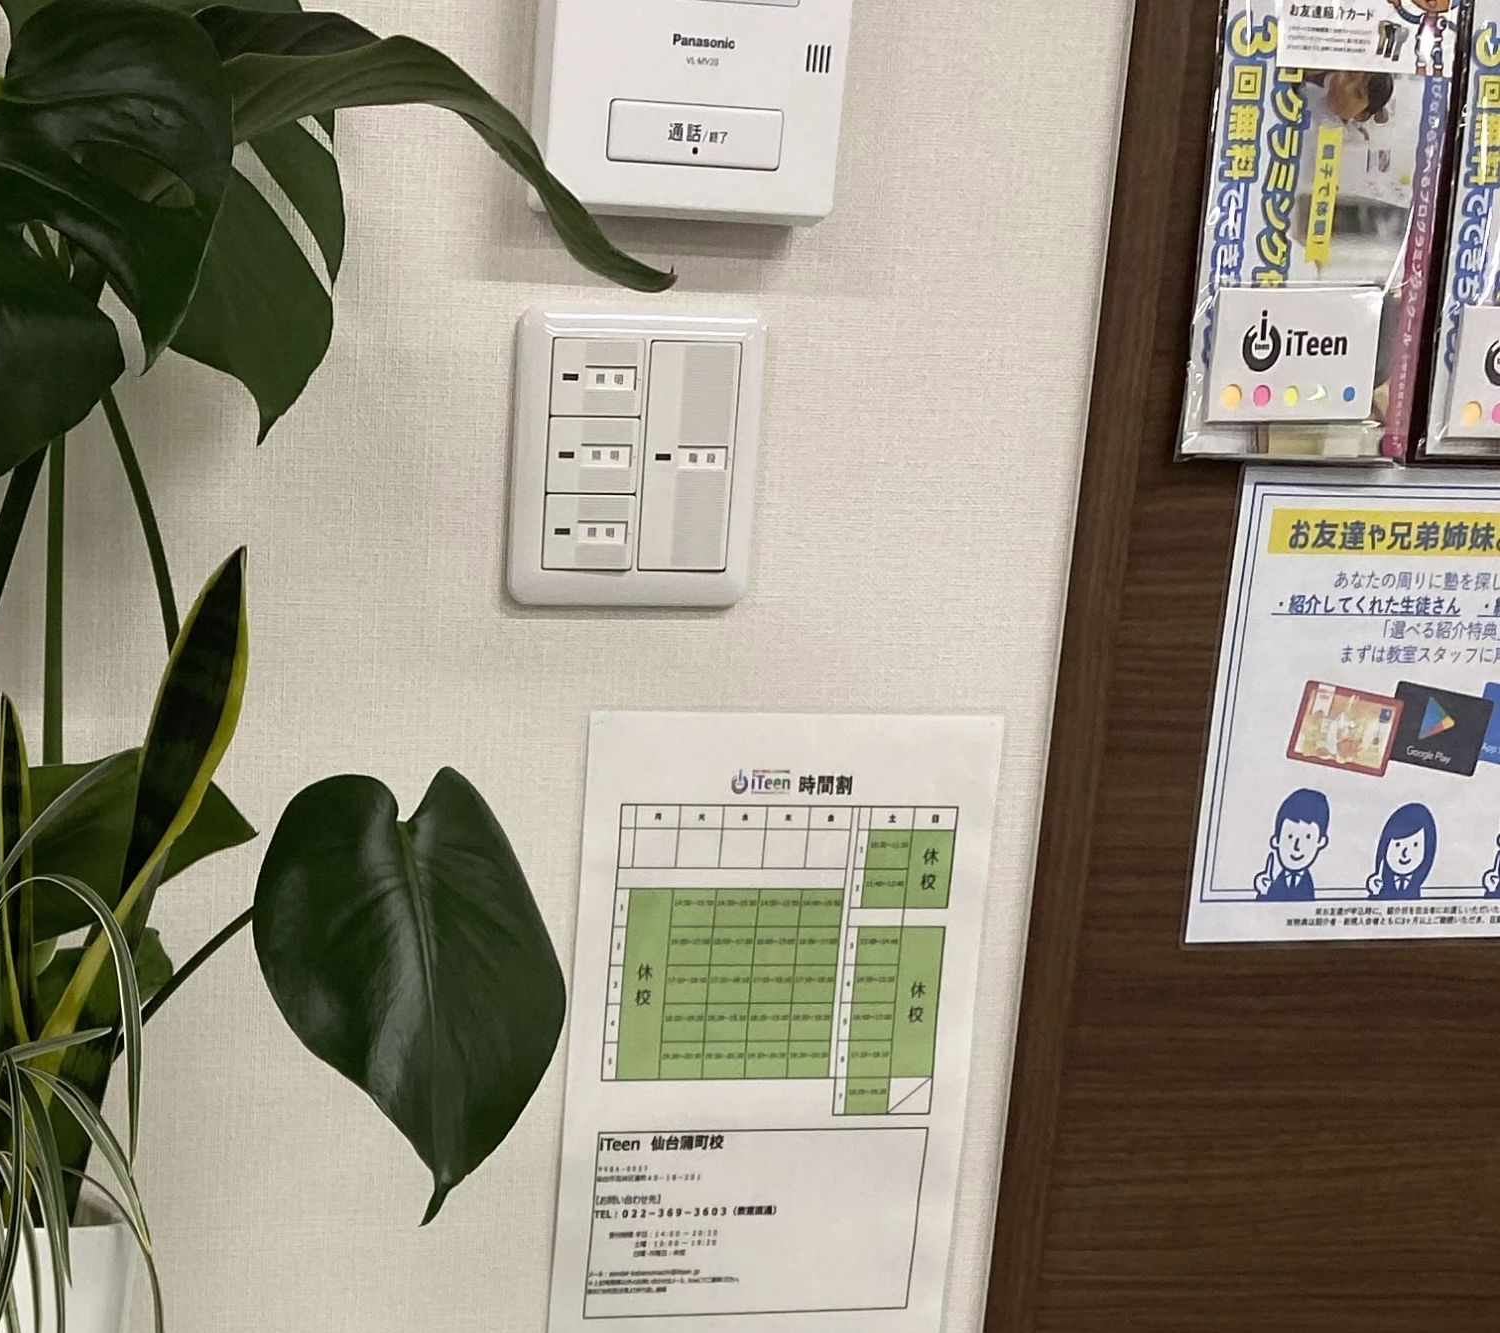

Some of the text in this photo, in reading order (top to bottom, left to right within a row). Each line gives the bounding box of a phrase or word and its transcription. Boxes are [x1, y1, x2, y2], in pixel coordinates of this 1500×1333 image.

[672, 32, 736, 51] Panasonic
[666, 121, 729, 146] 通話/終了
[1285, 328, 1349, 357] iTeen
[1405, 744, 1453, 766] Google Play
[750, 773, 853, 796] iTeen 時間割
[599, 1136, 641, 1152] iTeen
